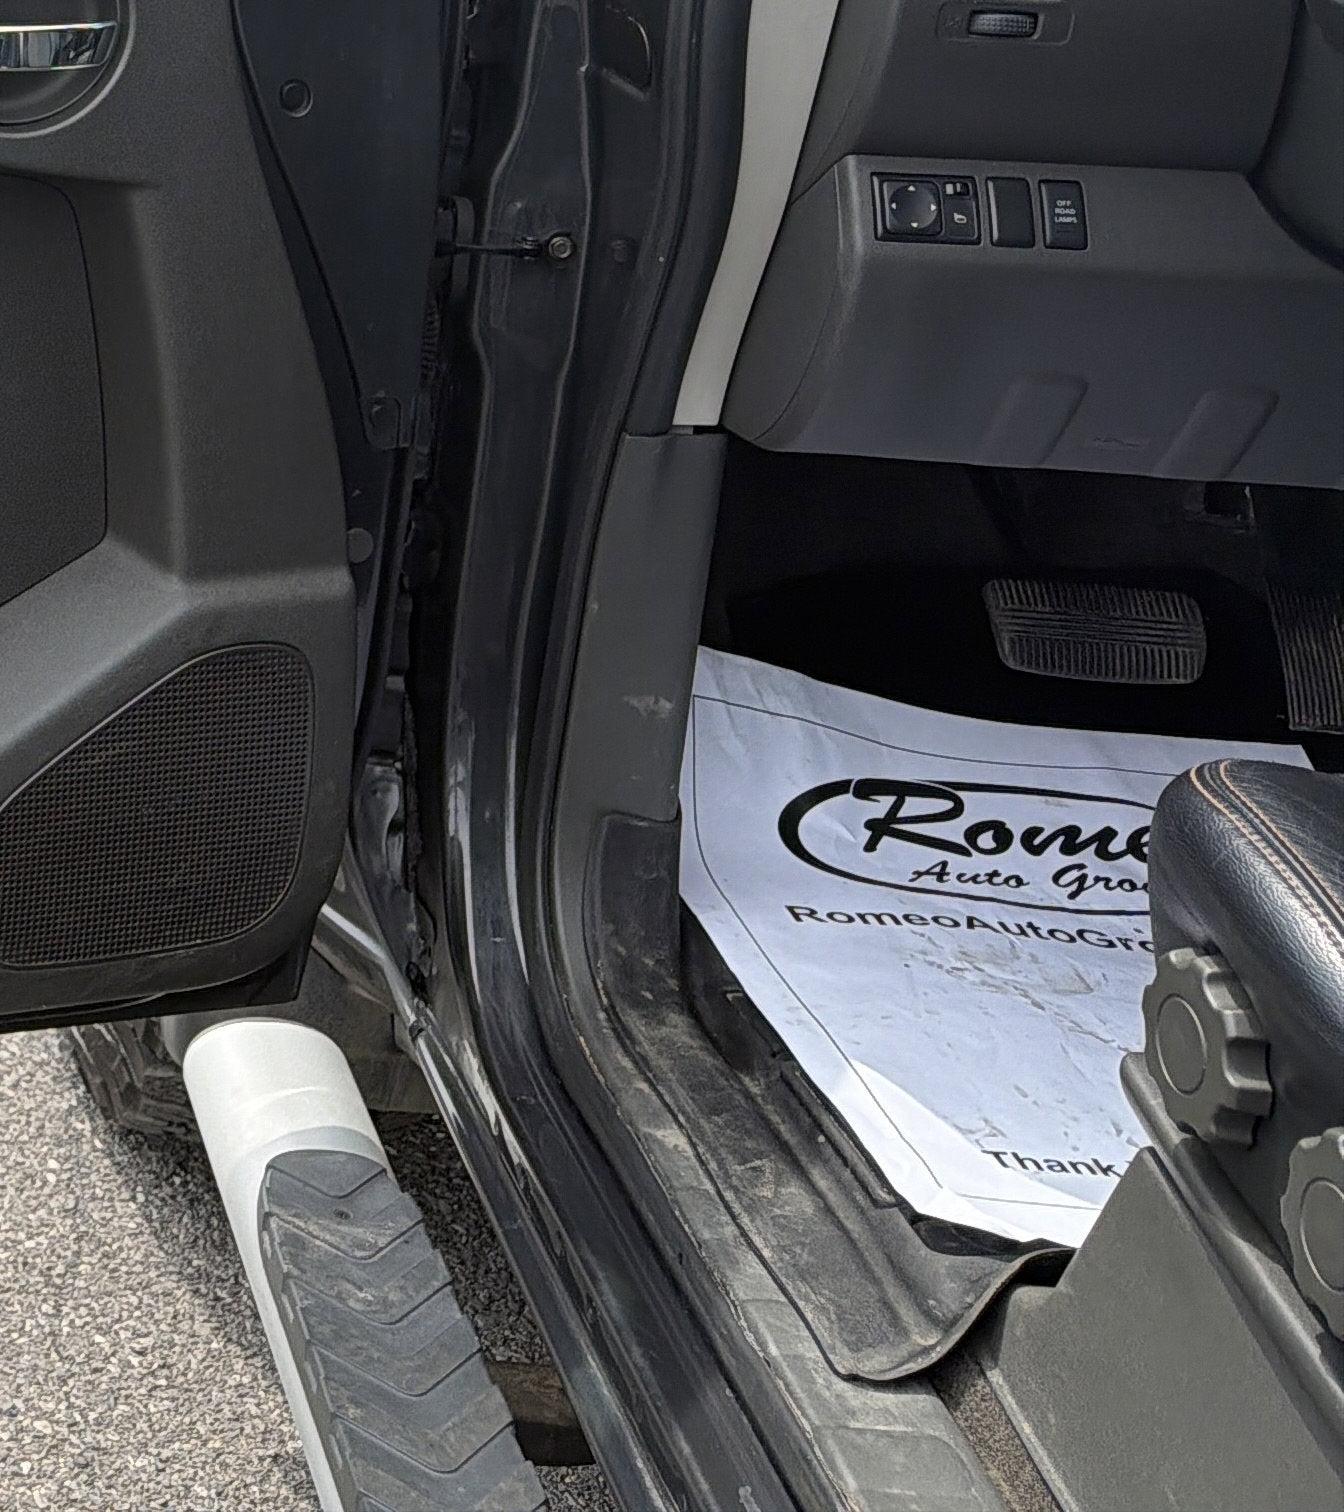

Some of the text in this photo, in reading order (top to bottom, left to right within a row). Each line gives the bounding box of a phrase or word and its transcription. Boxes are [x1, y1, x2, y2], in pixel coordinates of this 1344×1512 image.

[1054, 207, 1076, 215] ROAD
[1056, 199, 1072, 207] OFF
[1054, 216, 1078, 224] LAMPS
[850, 778, 1152, 864] Rome
[909, 859, 1150, 900] Auto Gro
[784, 904, 1154, 954] RomeoAutoGr
[981, 1148, 1124, 1178] Thank
